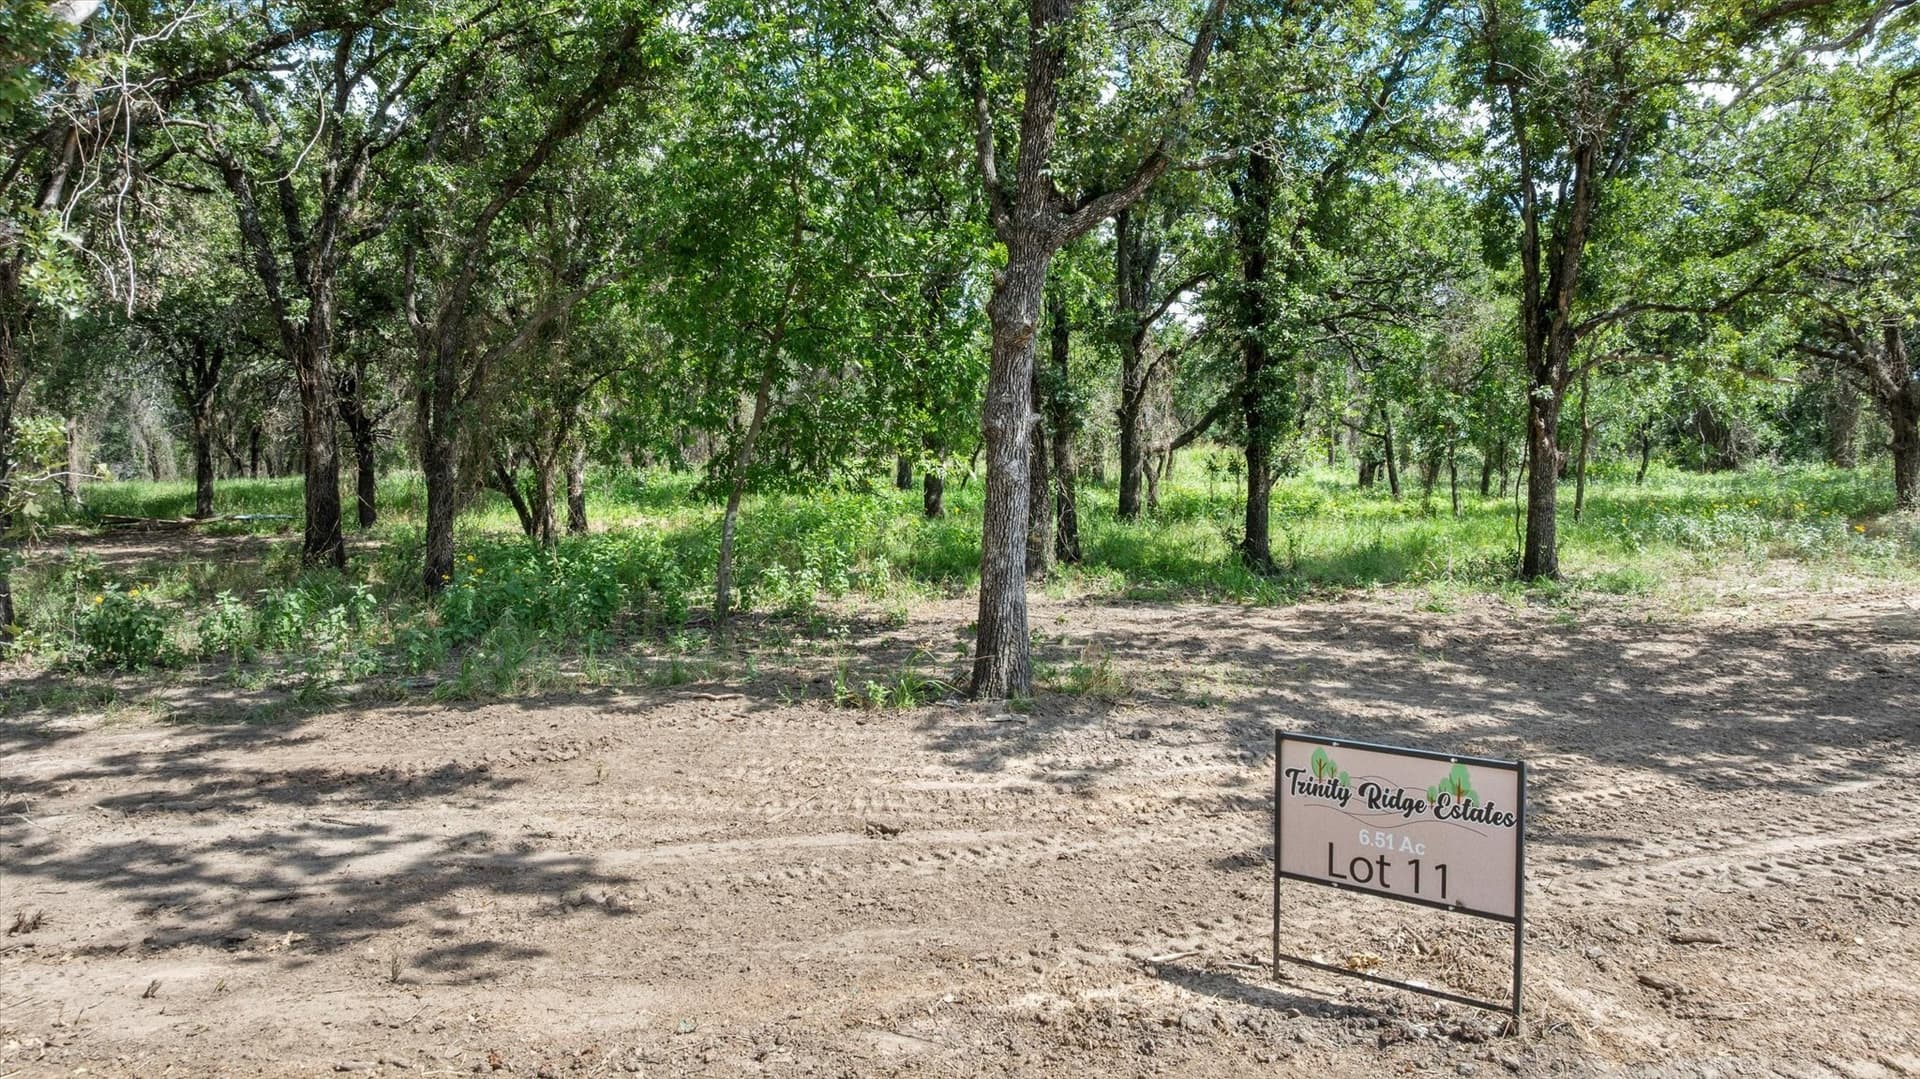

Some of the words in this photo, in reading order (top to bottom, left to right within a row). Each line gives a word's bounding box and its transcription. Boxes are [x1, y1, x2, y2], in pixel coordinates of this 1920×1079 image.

[1285, 768, 1351, 807] Trinity
[1358, 782, 1427, 818] Ridge
[1434, 793, 1517, 827] Estates
[1328, 842, 1391, 888] Lot
[1408, 859, 1447, 899] 11
[1359, 829, 1394, 850] 6.51
[1400, 836, 1425, 855] Ac
